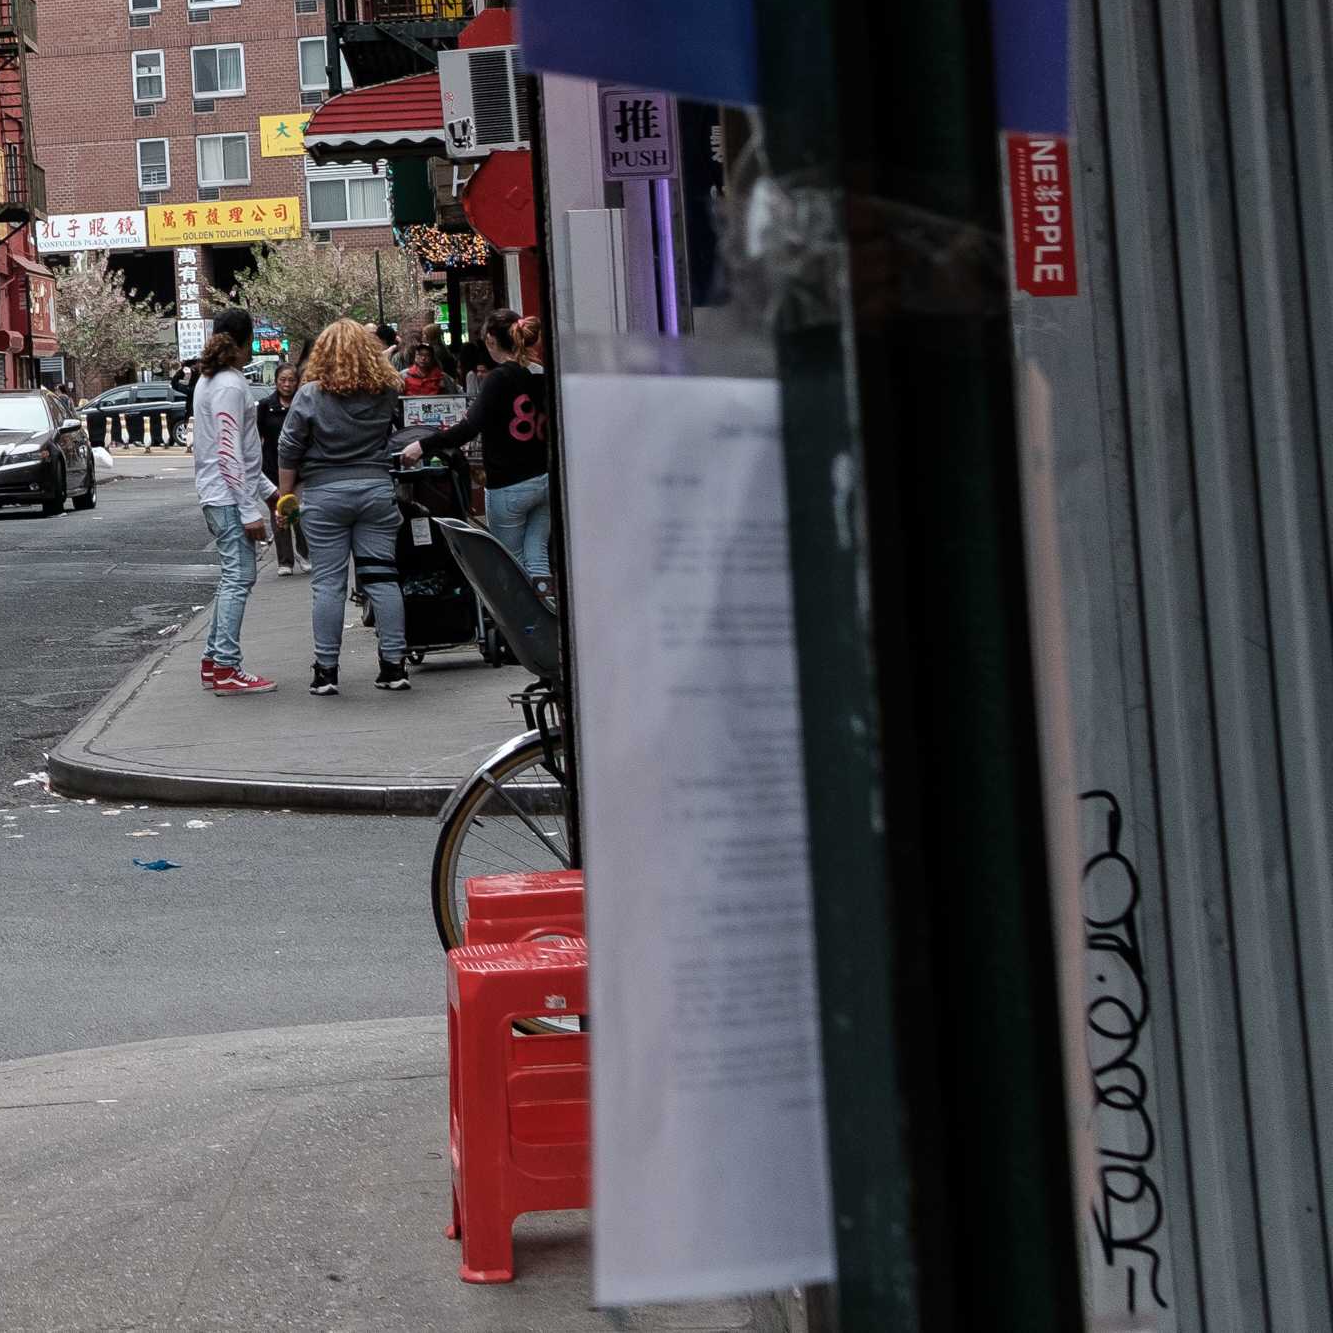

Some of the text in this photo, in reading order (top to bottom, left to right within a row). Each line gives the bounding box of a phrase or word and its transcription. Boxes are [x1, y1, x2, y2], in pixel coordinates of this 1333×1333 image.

[613, 100, 661, 143] 推
[611, 150, 667, 167] PUSH
[41, 215, 139, 239] 孔子眼鏡
[162, 203, 289, 228] 萬有護理公司
[39, 236, 142, 250] CONFUCIUS PLAZA OPTICAL
[182, 226, 289, 241] GOLDEN TOUCH HOME CARE
[177, 248, 201, 320] 萬有護理
